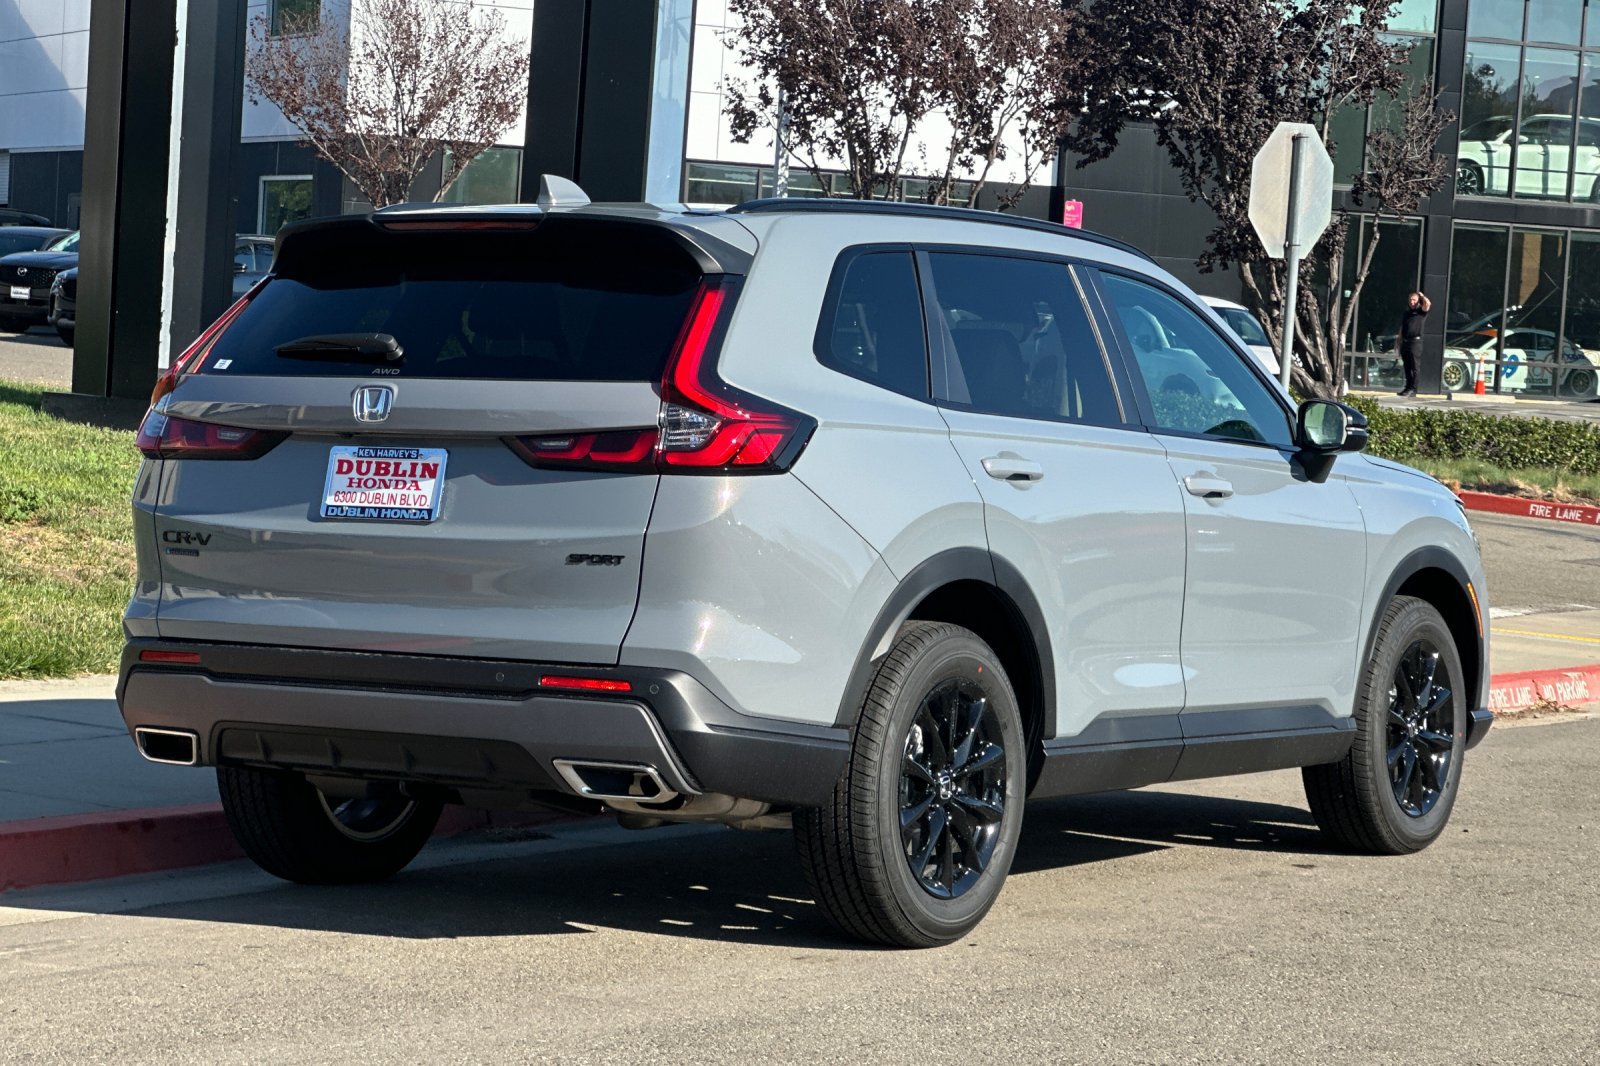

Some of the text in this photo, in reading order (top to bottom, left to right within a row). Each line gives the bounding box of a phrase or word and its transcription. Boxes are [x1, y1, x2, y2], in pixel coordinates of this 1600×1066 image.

[358, 449, 418, 458] KEN HARVEY'S
[335, 459, 439, 479] DUBLIN
[346, 477, 421, 491] HONDA
[334, 491, 430, 507] 6300 DUBLIN BLVD.
[328, 506, 429, 520] DUBLIN HONDA
[1529, 503, 1552, 518] FIRE
[1556, 507, 1583, 521] LANE
[162, 530, 212, 546] CR-V
[565, 553, 626, 566] SPORT
[1489, 680, 1589, 708] FIRE LANE NO PARKING
